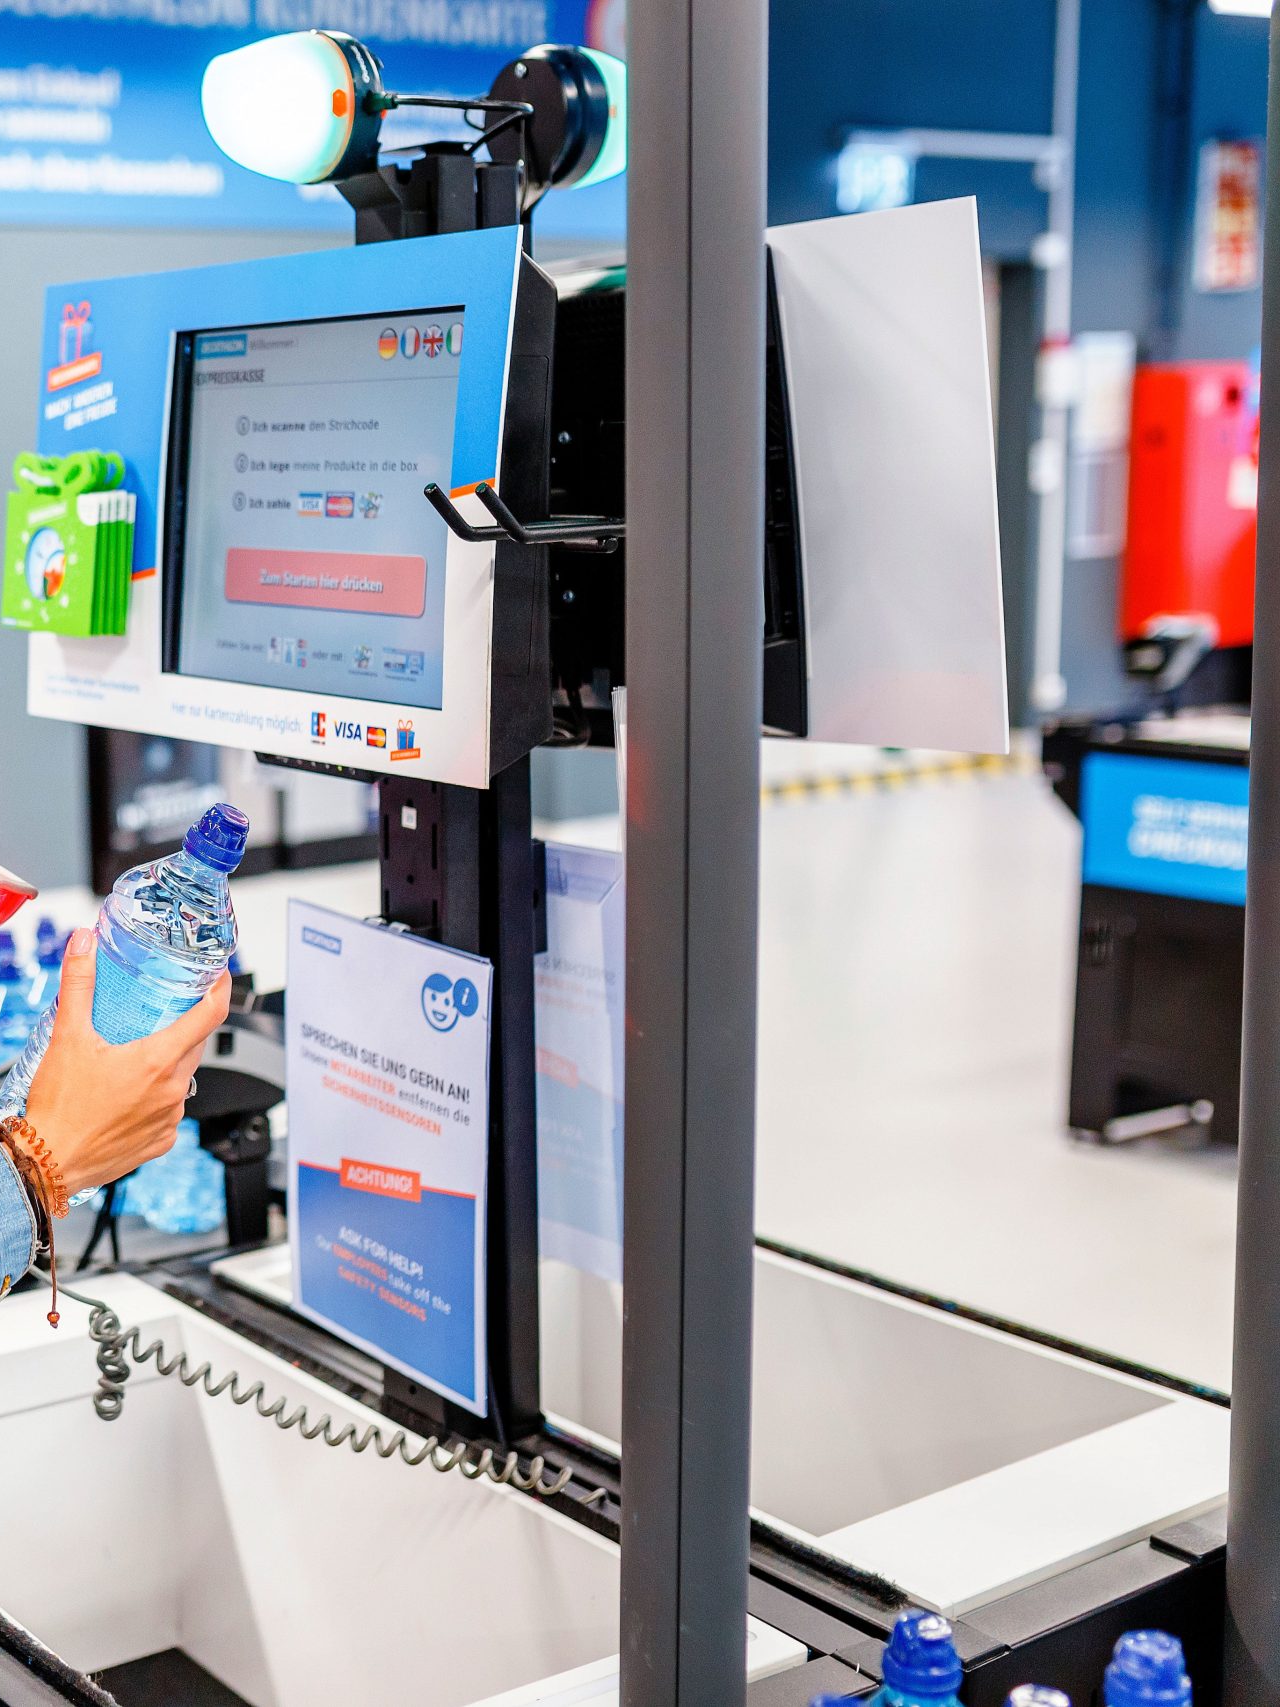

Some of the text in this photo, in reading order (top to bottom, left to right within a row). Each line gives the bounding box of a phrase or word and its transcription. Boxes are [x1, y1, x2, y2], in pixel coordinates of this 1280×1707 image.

[271, 423, 305, 432] scanne
[309, 420, 326, 432] den
[329, 418, 380, 431] Strichcode
[324, 460, 367, 472] Produkte
[382, 460, 397, 472] die
[400, 460, 419, 472] box
[284, 571, 318, 588] Starten
[320, 573, 340, 589] hier
[342, 575, 384, 592] drücken
[204, 705, 264, 730] Kartenzahlung
[334, 721, 361, 740] VISA
[302, 1023, 470, 1104] SPRECHEN SIE UNS GERN AN!
[399, 1089, 450, 1118] entfernen
[453, 1108, 470, 1126] die
[346, 1165, 414, 1194] ACHTUNG!
[339, 1226, 424, 1281] ASK FOR HELP!
[432, 1295, 452, 1315] the
